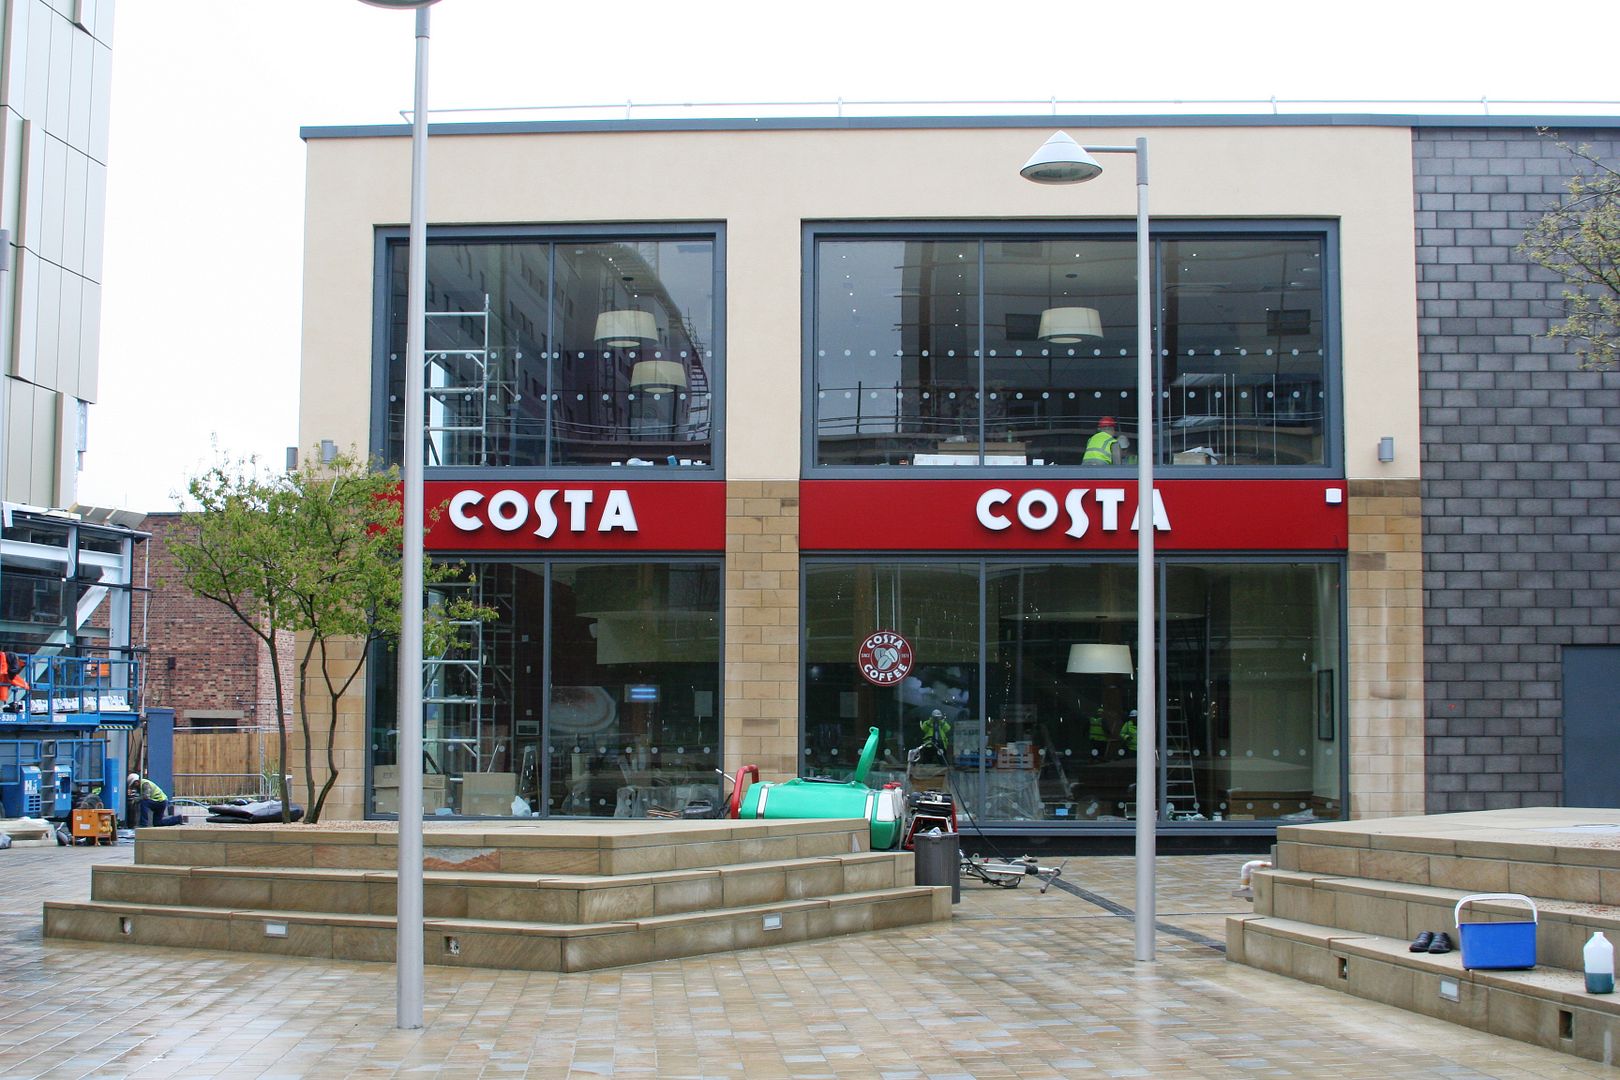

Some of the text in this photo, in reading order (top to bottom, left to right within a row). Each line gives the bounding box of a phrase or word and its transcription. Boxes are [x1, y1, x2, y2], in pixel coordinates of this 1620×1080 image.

[448, 489, 639, 539] COSTA
[976, 488, 1172, 539] COSTA
[866, 634, 903, 649] COSTA
[864, 663, 907, 681] COFFEE
